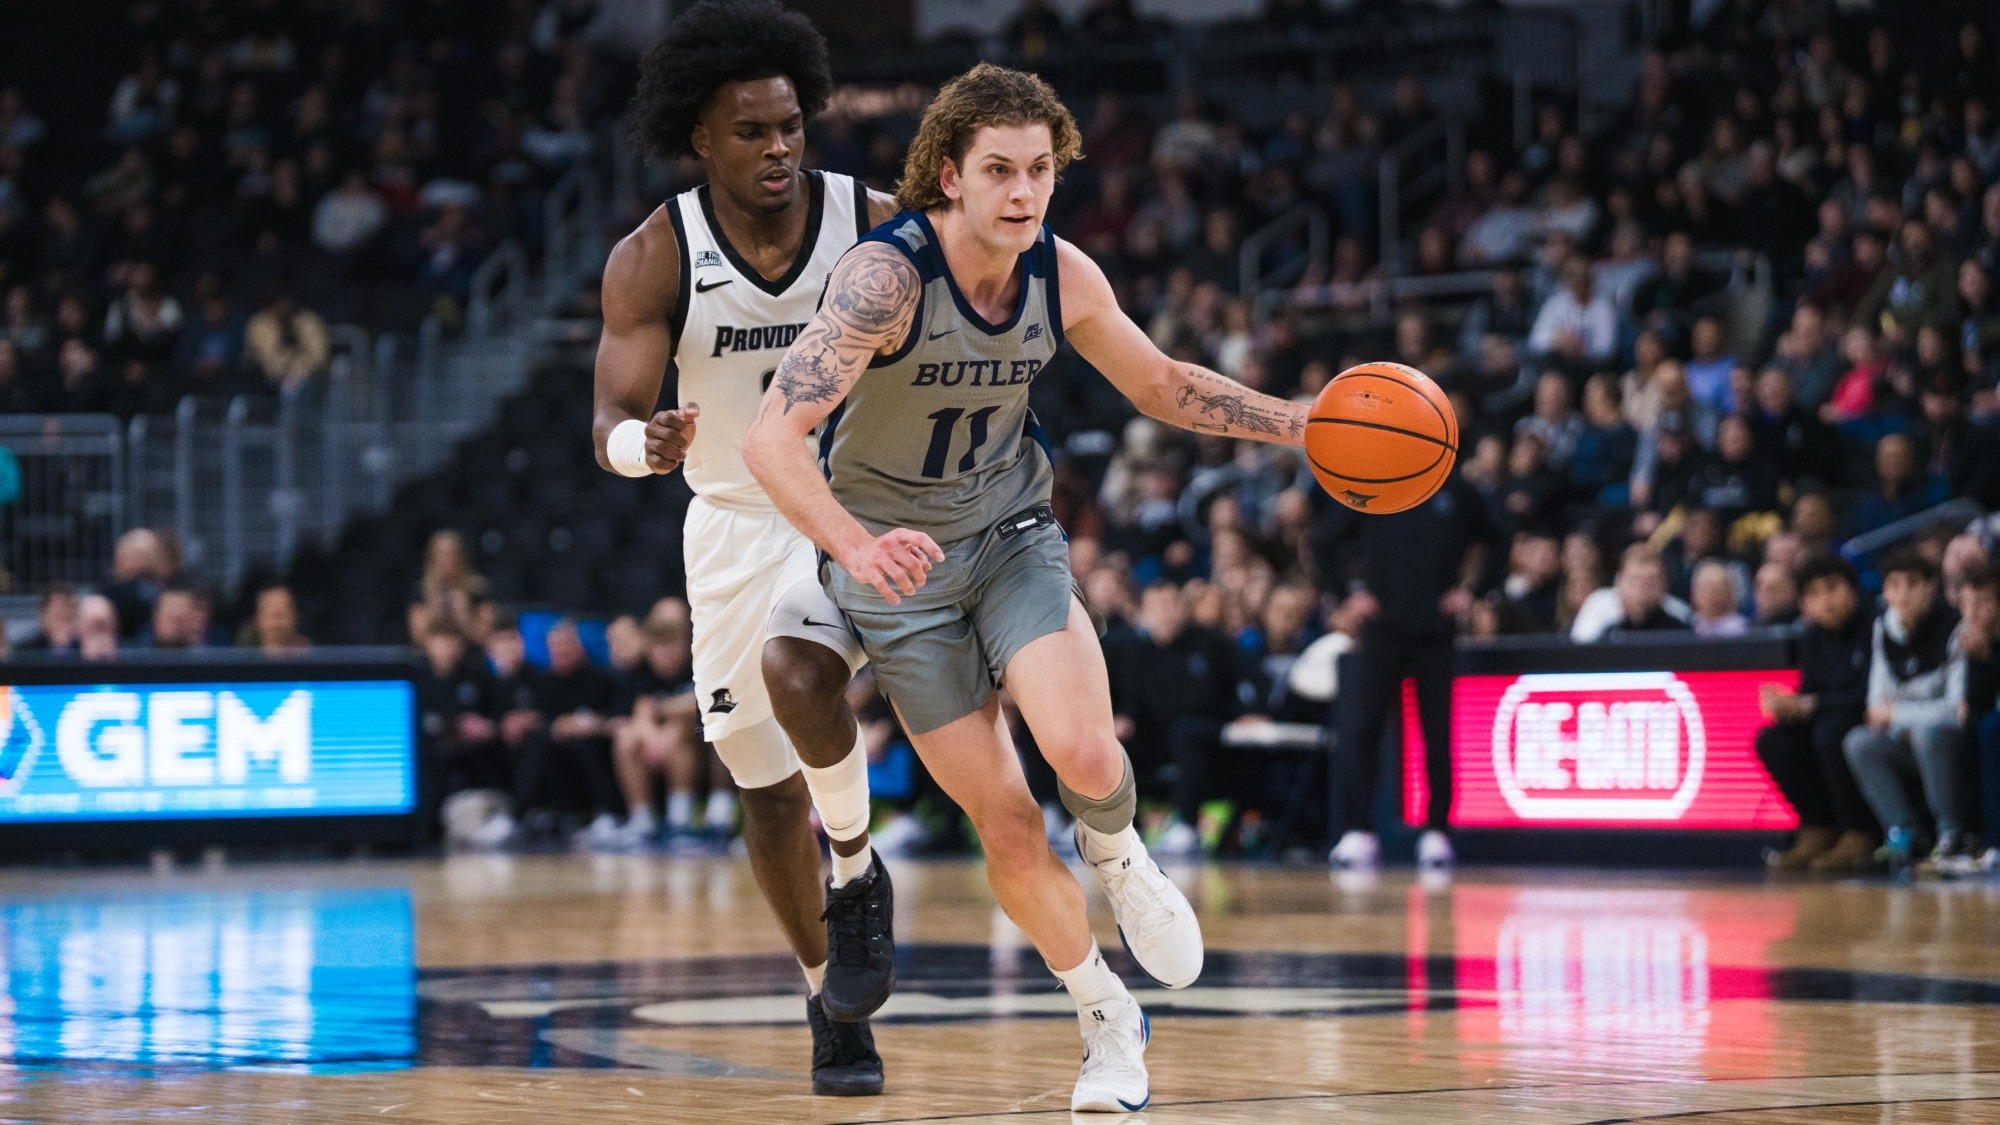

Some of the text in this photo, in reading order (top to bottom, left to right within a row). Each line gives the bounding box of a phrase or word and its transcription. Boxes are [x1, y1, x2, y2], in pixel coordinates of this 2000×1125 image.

[695, 259, 722, 268] CHANGE
[911, 360, 1042, 386] BUTLER
[921, 405, 1002, 479] 11
[55, 690, 314, 787] GEM
